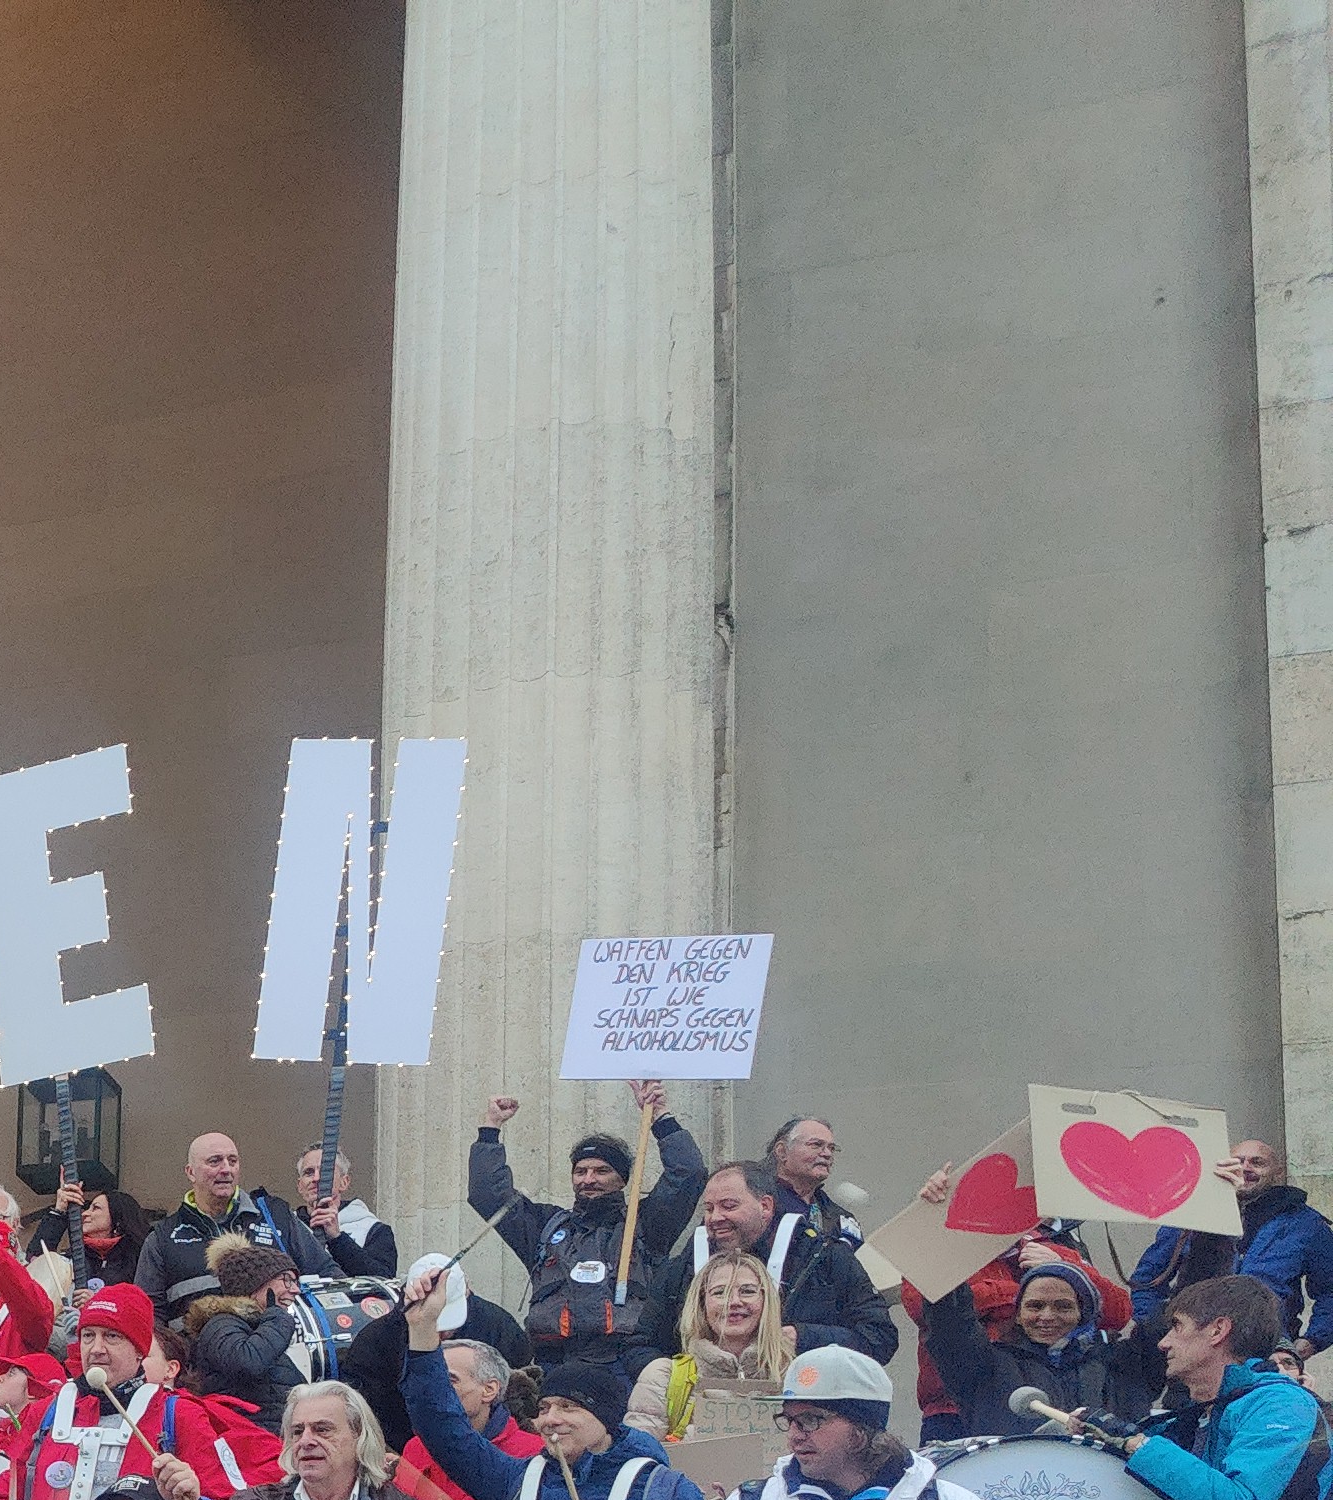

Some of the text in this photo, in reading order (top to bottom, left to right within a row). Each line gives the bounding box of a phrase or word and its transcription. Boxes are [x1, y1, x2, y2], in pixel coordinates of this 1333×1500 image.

[592, 937, 753, 963] WAFFEN GEGEN
[611, 960, 731, 985] DEN KRIEG
[622, 986, 710, 1007] IST WIE
[593, 1007, 755, 1029] SCHNAPS GEGEN
[601, 1029, 753, 1052] ALKOHOLISMUS
